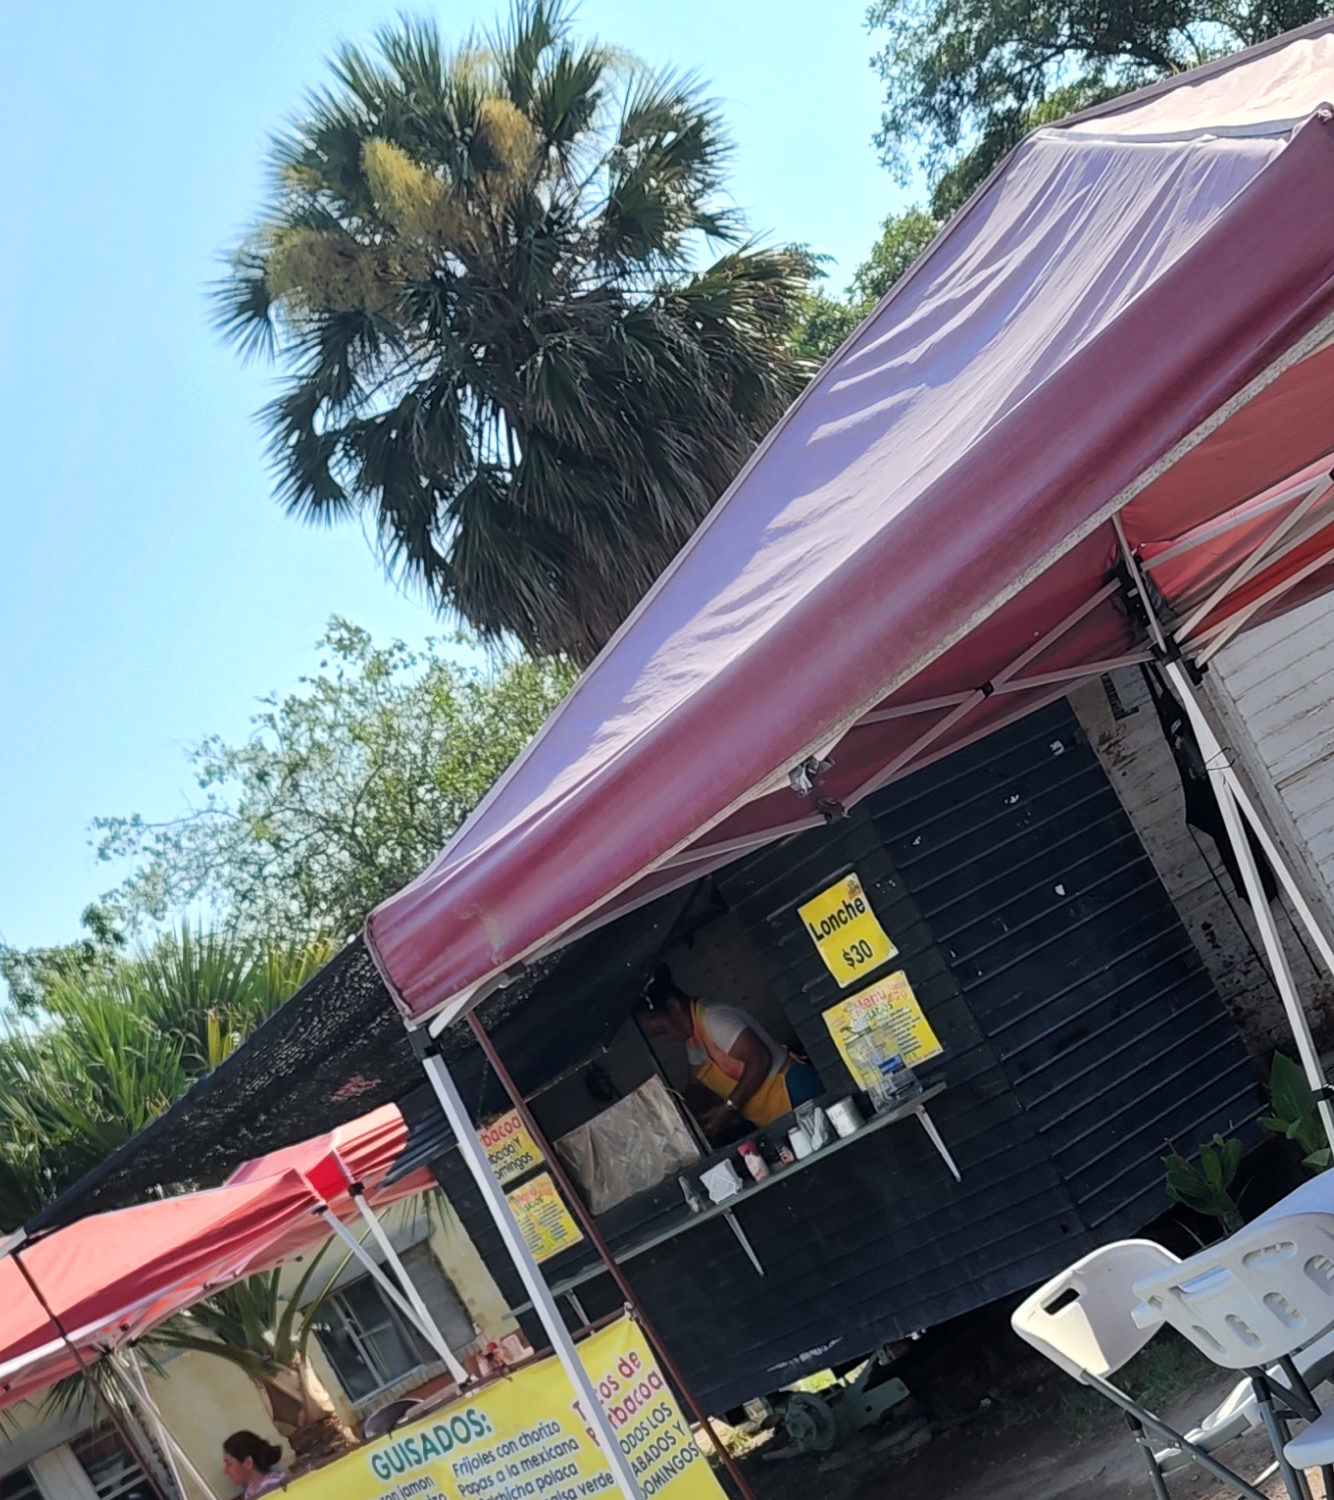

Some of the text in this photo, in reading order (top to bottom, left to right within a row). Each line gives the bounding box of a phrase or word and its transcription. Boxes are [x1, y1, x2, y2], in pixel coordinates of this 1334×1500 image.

[809, 897, 866, 942] Lonche
[842, 938, 874, 970] $30
[480, 1116, 522, 1147] bacoa
[494, 1152, 533, 1179] omingos
[573, 1351, 641, 1422] Tos de
[586, 1370, 664, 1447] rbacoa
[371, 1409, 492, 1480] GUISADOS:
[452, 1421, 561, 1478] Frijoles con chorizo
[619, 1402, 673, 1456] ODOS LOS
[631, 1420, 686, 1477] ABADOS Y
[457, 1438, 579, 1497] Papas a la mexicana
[535, 1462, 579, 1492] polaca
[577, 1471, 615, 1496] verde
